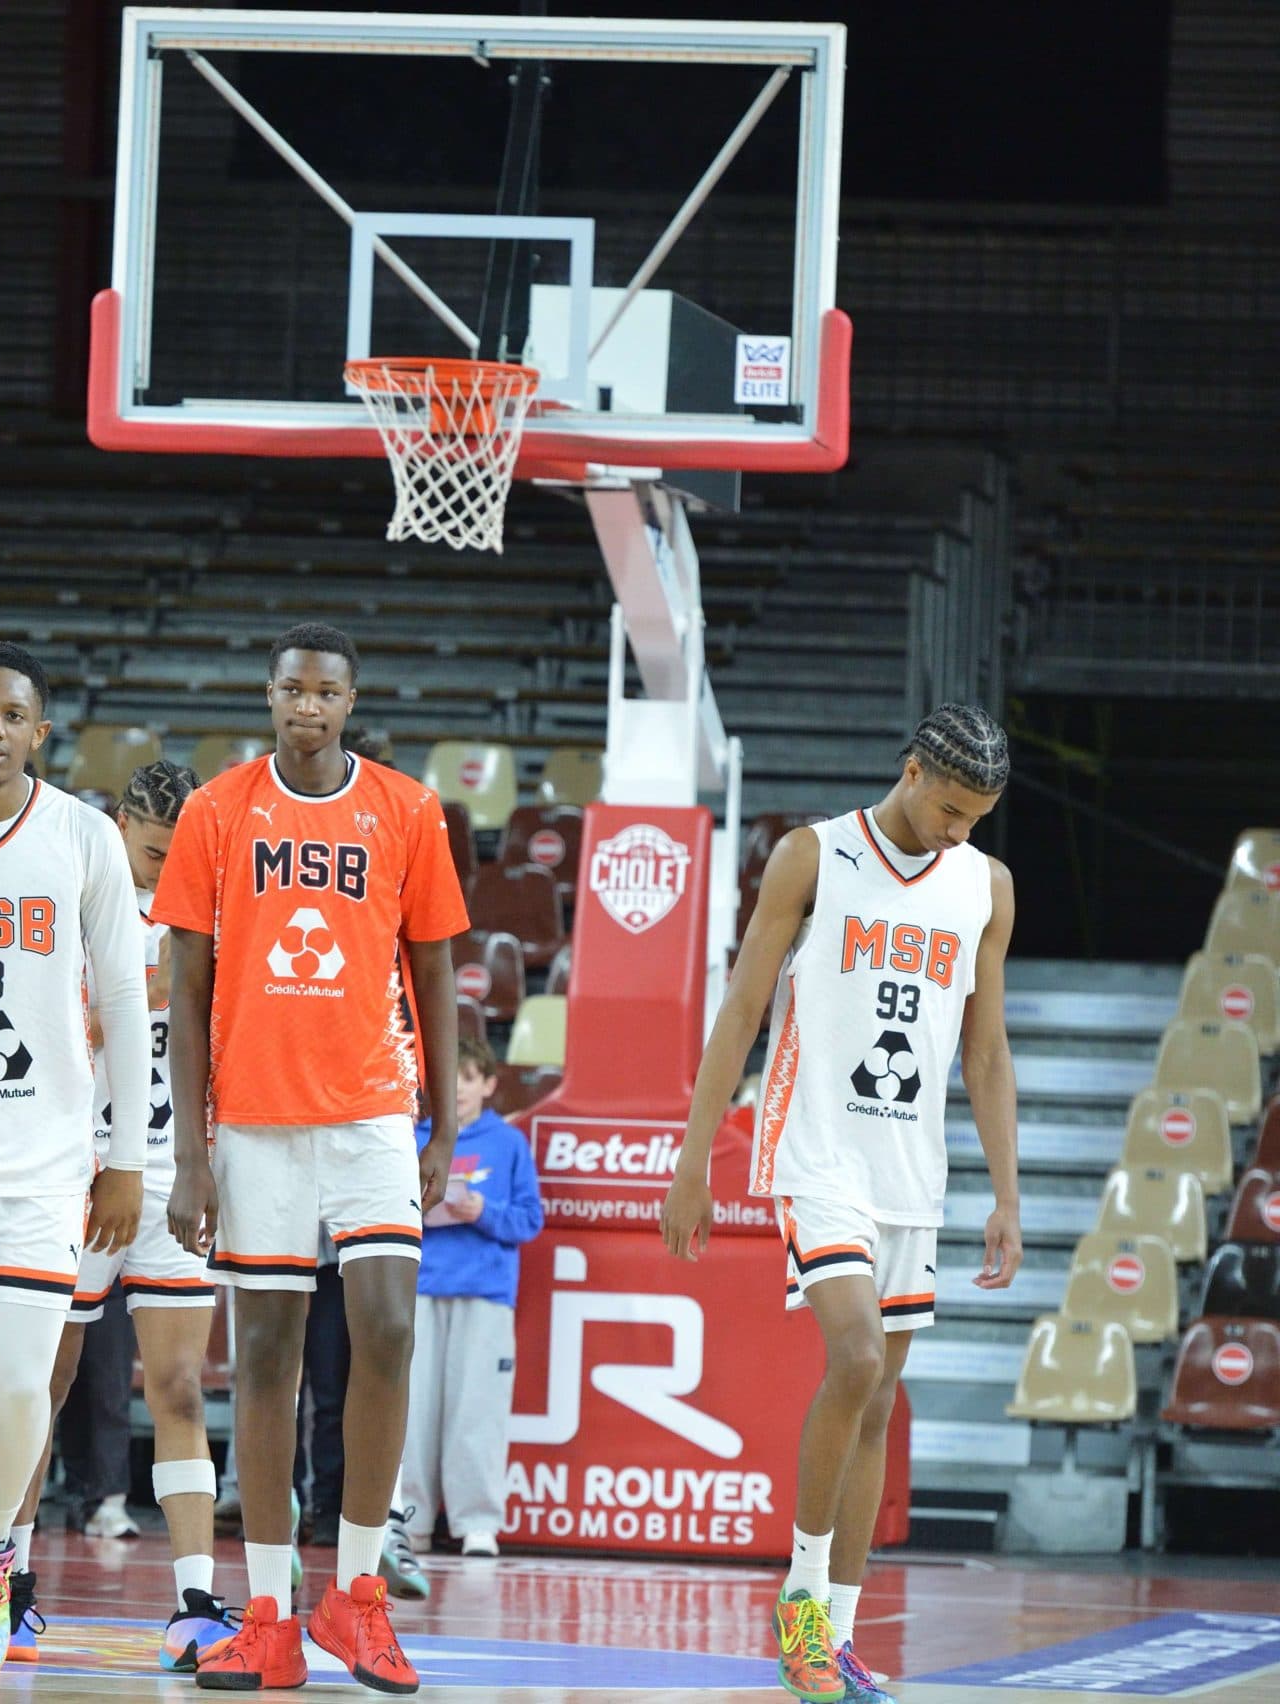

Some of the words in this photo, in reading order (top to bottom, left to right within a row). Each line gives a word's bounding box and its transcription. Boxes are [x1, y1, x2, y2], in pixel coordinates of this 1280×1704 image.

[253, 837, 370, 904] MSB
[589, 852, 692, 896] CHOLET
[840, 915, 961, 989] MSB
[264, 983, 297, 996] Crédit
[308, 986, 345, 998] Mutuel
[875, 980, 921, 1024] 93
[846, 1101, 880, 1117] Crédit
[506, 1460, 568, 1504] AN
[583, 1464, 775, 1515] ROUYER
[502, 1505, 755, 1546] UTOMOBILES
